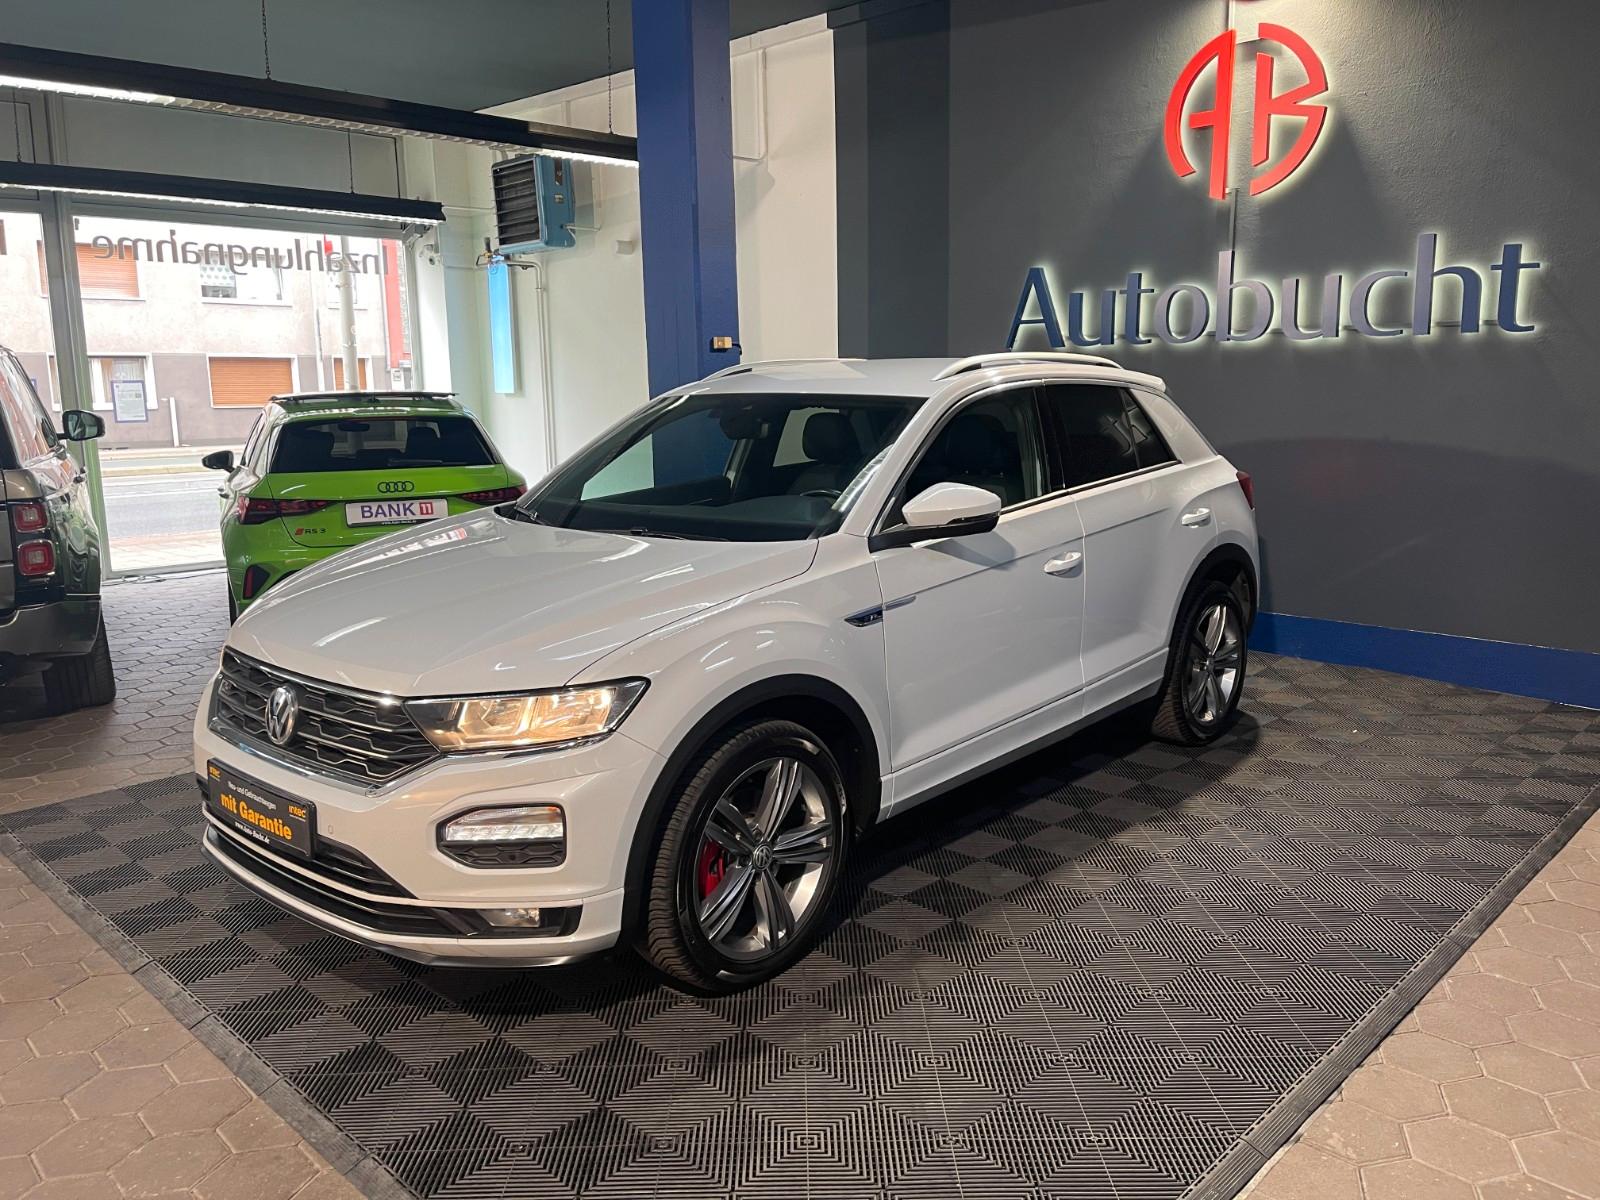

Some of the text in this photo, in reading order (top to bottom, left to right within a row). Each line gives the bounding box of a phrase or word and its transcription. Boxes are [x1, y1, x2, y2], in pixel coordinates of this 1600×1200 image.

[1006, 233, 1541, 352] Autobucht
[360, 502, 433, 519] BANK 11
[220, 793, 292, 840] mit Garantie
